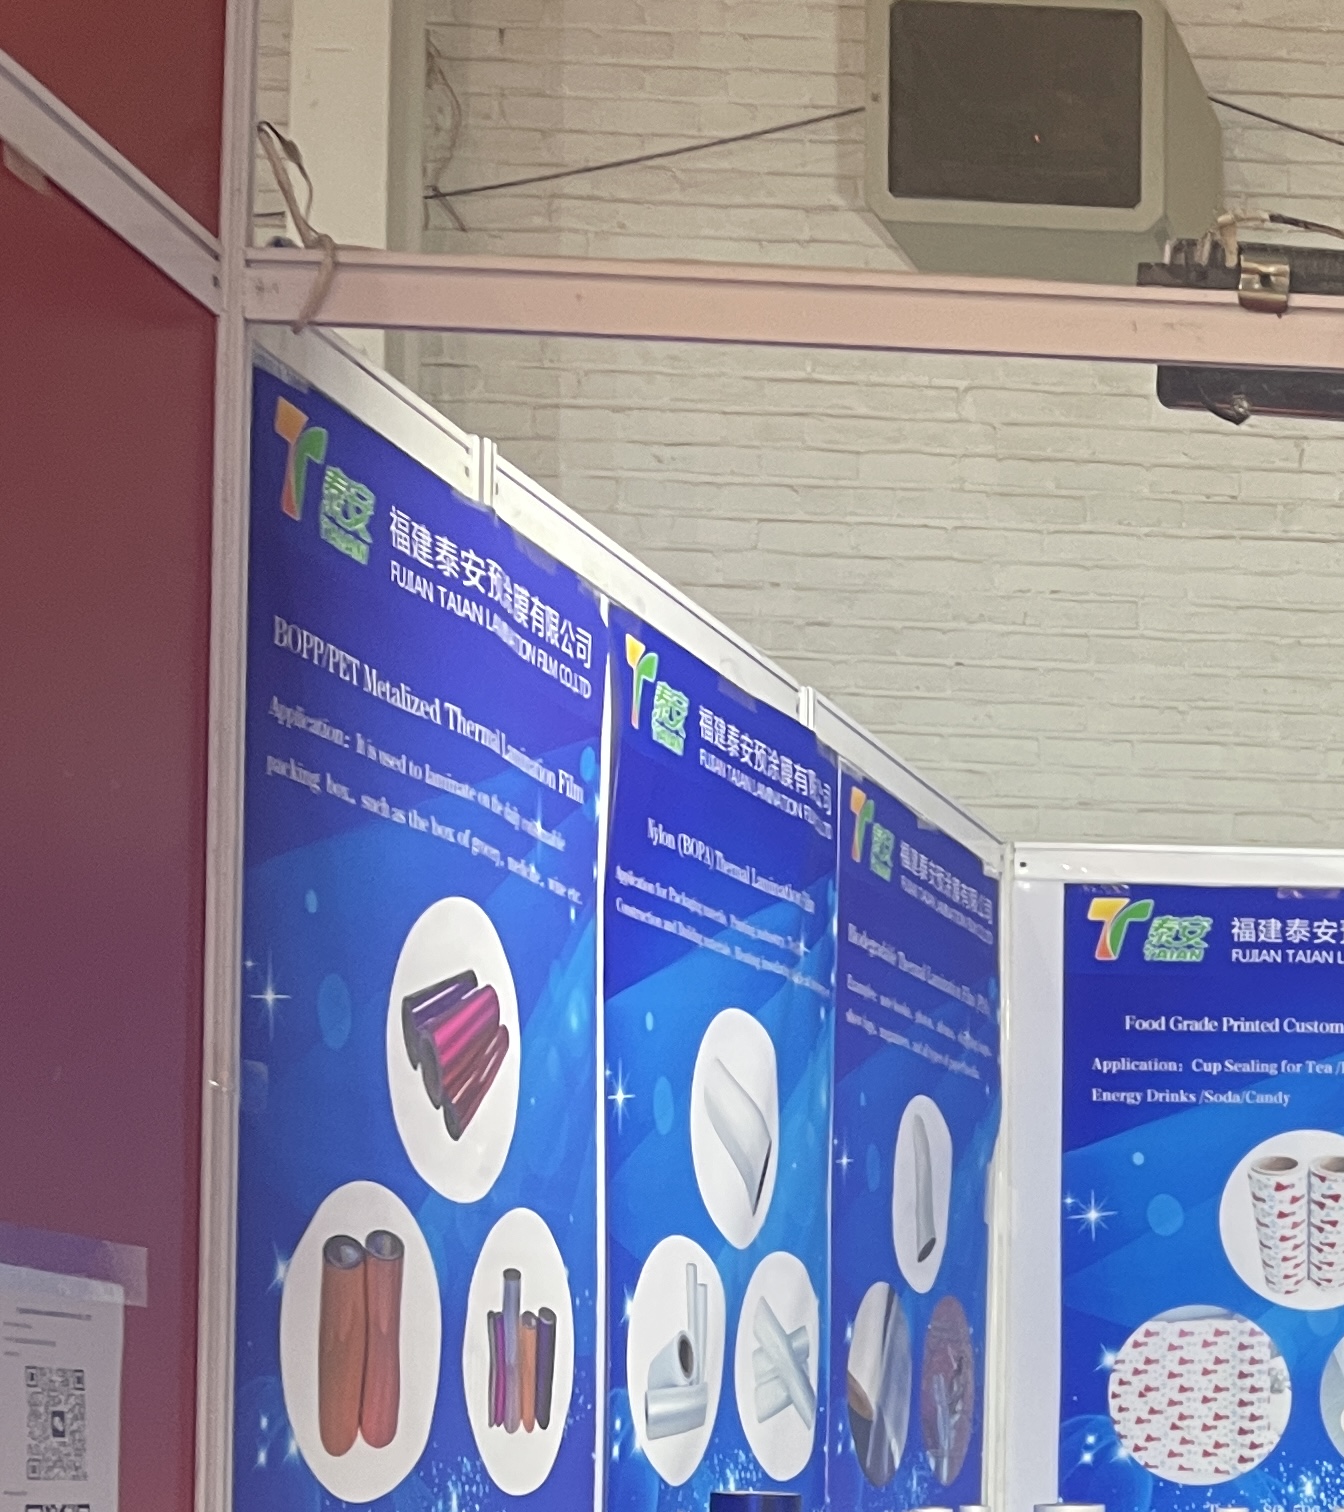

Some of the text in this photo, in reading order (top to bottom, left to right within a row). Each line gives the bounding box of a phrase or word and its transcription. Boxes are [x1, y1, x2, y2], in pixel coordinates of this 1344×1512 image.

[390, 560, 435, 603] FUJIAN
[437, 585, 484, 626] TAIAN
[486, 608, 537, 666] LATION
[274, 615, 359, 686] BOPP/PET
[362, 664, 441, 725] Metalized
[444, 702, 500, 754] Thermal
[558, 769, 584, 804] Film
[409, 760, 422, 780] to
[1149, 914, 1213, 949] 泰安
[1143, 947, 1205, 962] TAIAN
[1231, 949, 1282, 963] FUJIAN
[1286, 950, 1334, 965] TAIAN
[1125, 1015, 1166, 1031] Food
[1169, 1016, 1218, 1032] Grade
[1222, 1017, 1279, 1033] Printed
[1283, 1018, 1344, 1034] Custom
[1091, 1057, 1183, 1074] Application:
[1192, 1059, 1222, 1075] Cup
[1224, 1059, 1278, 1076] Sealing
[1280, 1059, 1301, 1073] for
[1305, 1060, 1332, 1074] Tea
[1091, 1088, 1142, 1105] Energy
[1146, 1088, 1196, 1103] Drinks
